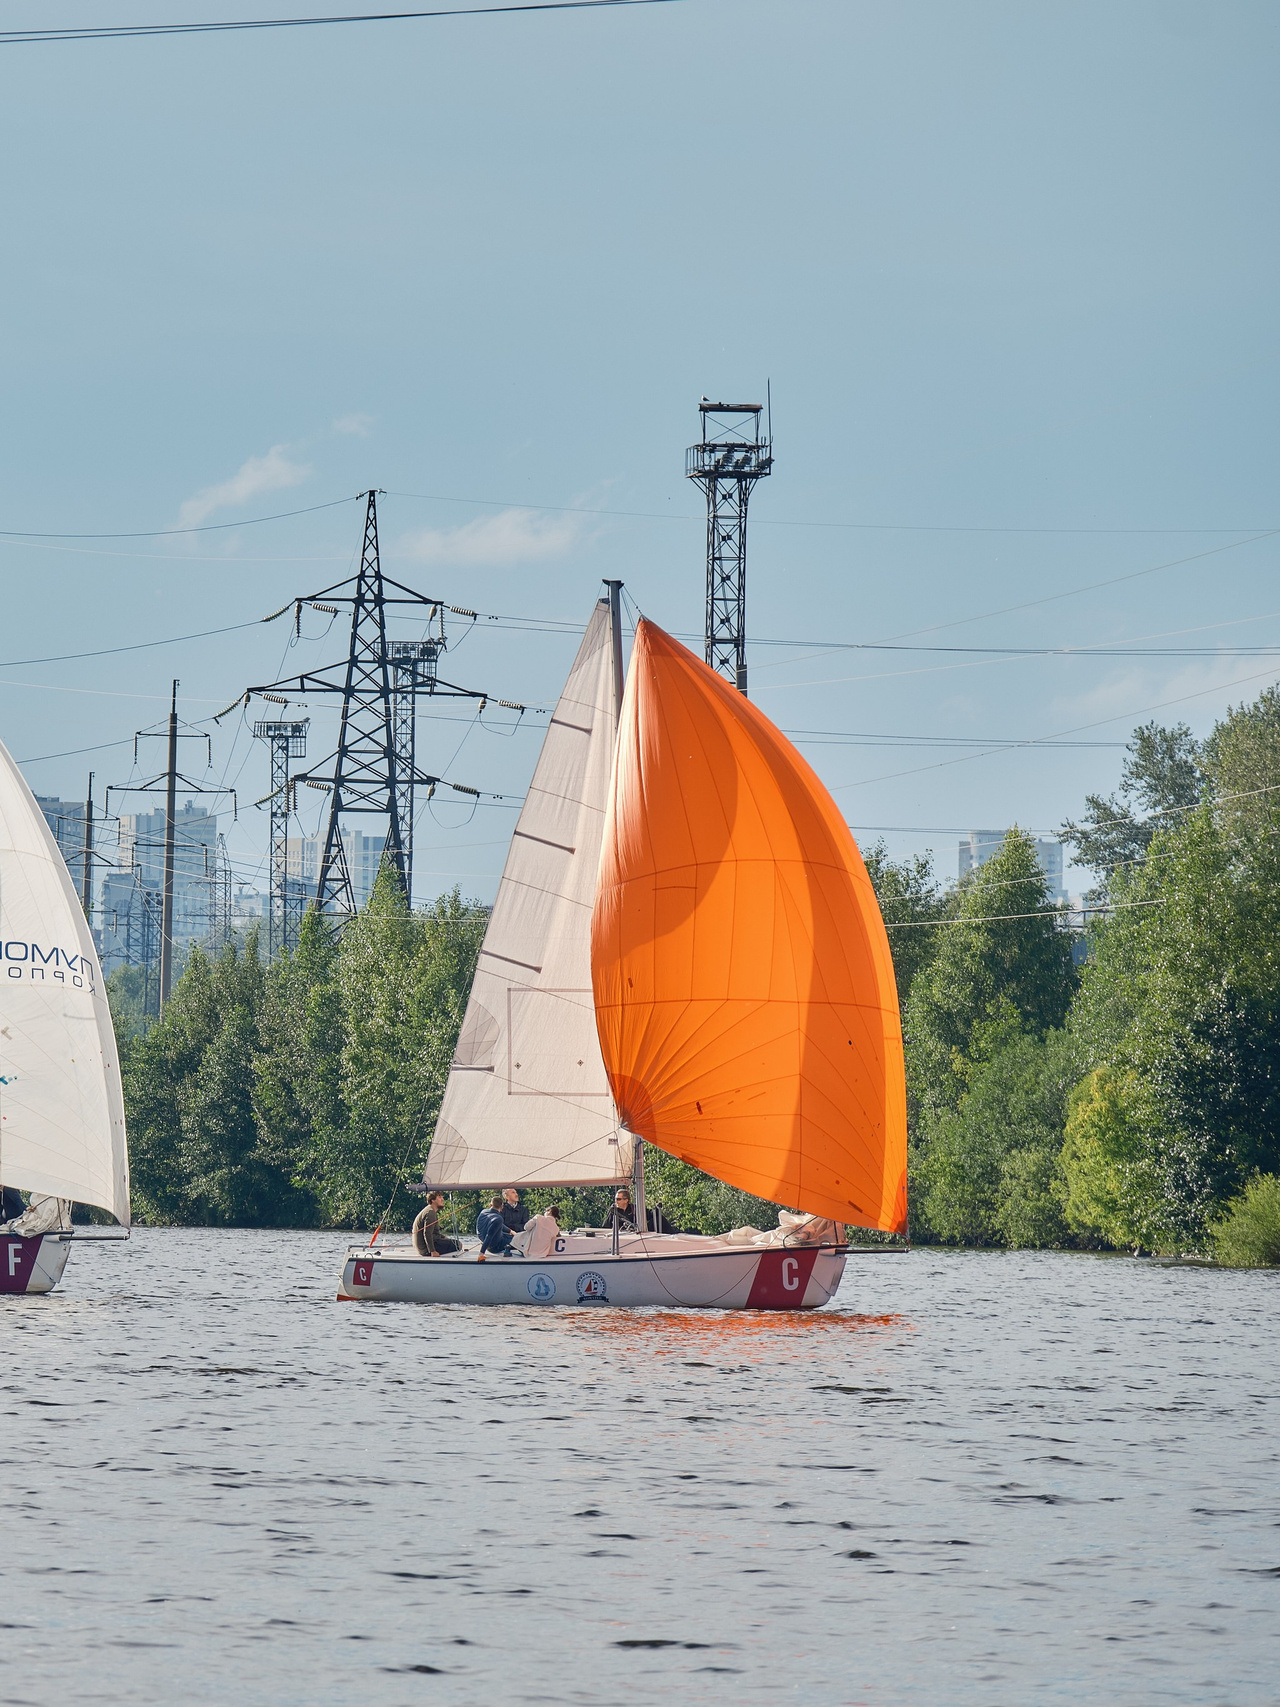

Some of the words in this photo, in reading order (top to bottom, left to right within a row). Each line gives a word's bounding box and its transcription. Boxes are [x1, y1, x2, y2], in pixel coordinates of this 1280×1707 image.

[554, 1238, 566, 1253] C
[8, 1243, 22, 1276] F
[359, 1267, 367, 1282] C
[781, 1257, 799, 1291] C
